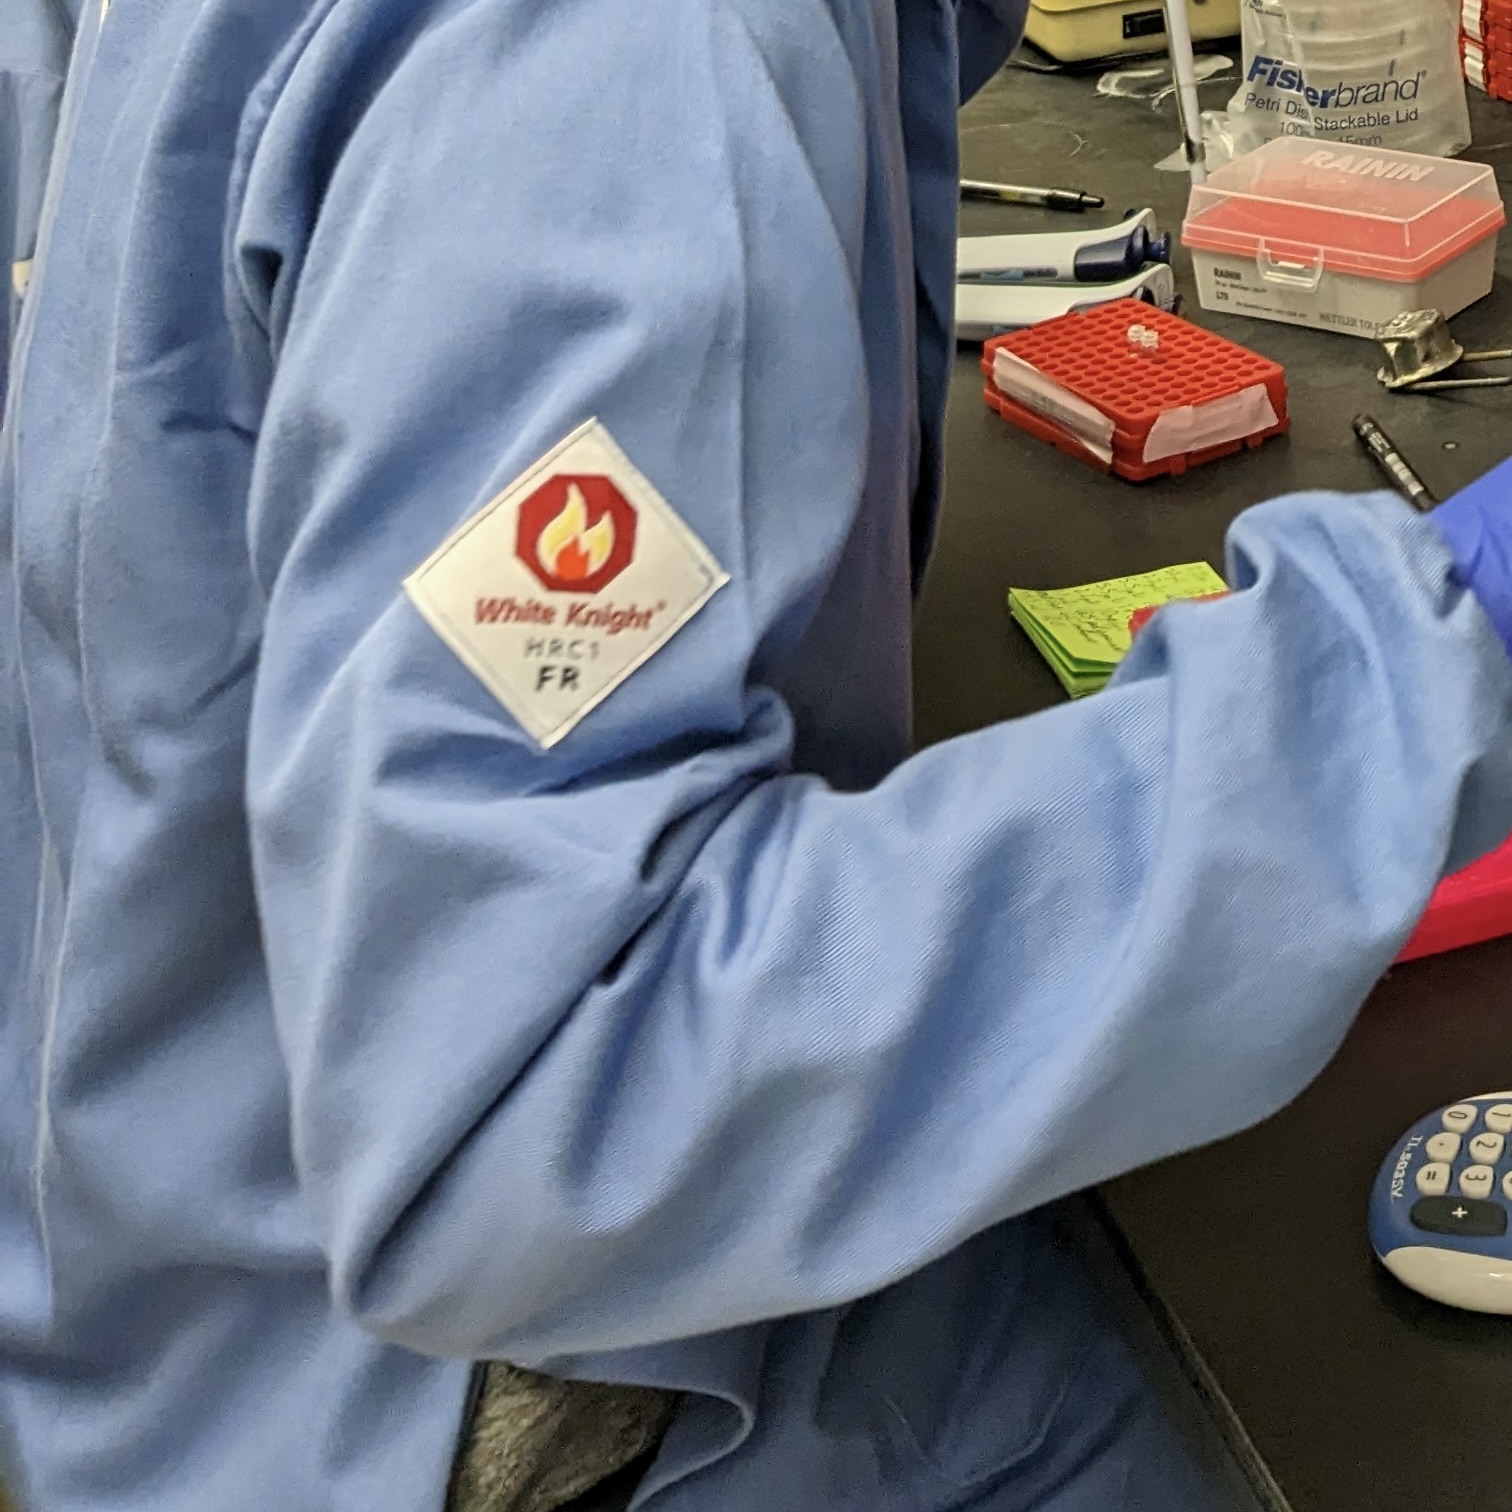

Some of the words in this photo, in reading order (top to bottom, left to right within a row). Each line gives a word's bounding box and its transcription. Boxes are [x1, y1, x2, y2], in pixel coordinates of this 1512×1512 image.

[1244, 92, 1281, 112] Petri
[1284, 100, 1310, 119] Dis
[1313, 111, 1391, 132] Stackable
[1396, 107, 1419, 124] Lid
[1301, 150, 1434, 182] RAININ
[474, 596, 556, 627] White
[564, 599, 656, 637] Knight
[534, 665, 582, 693] FR
